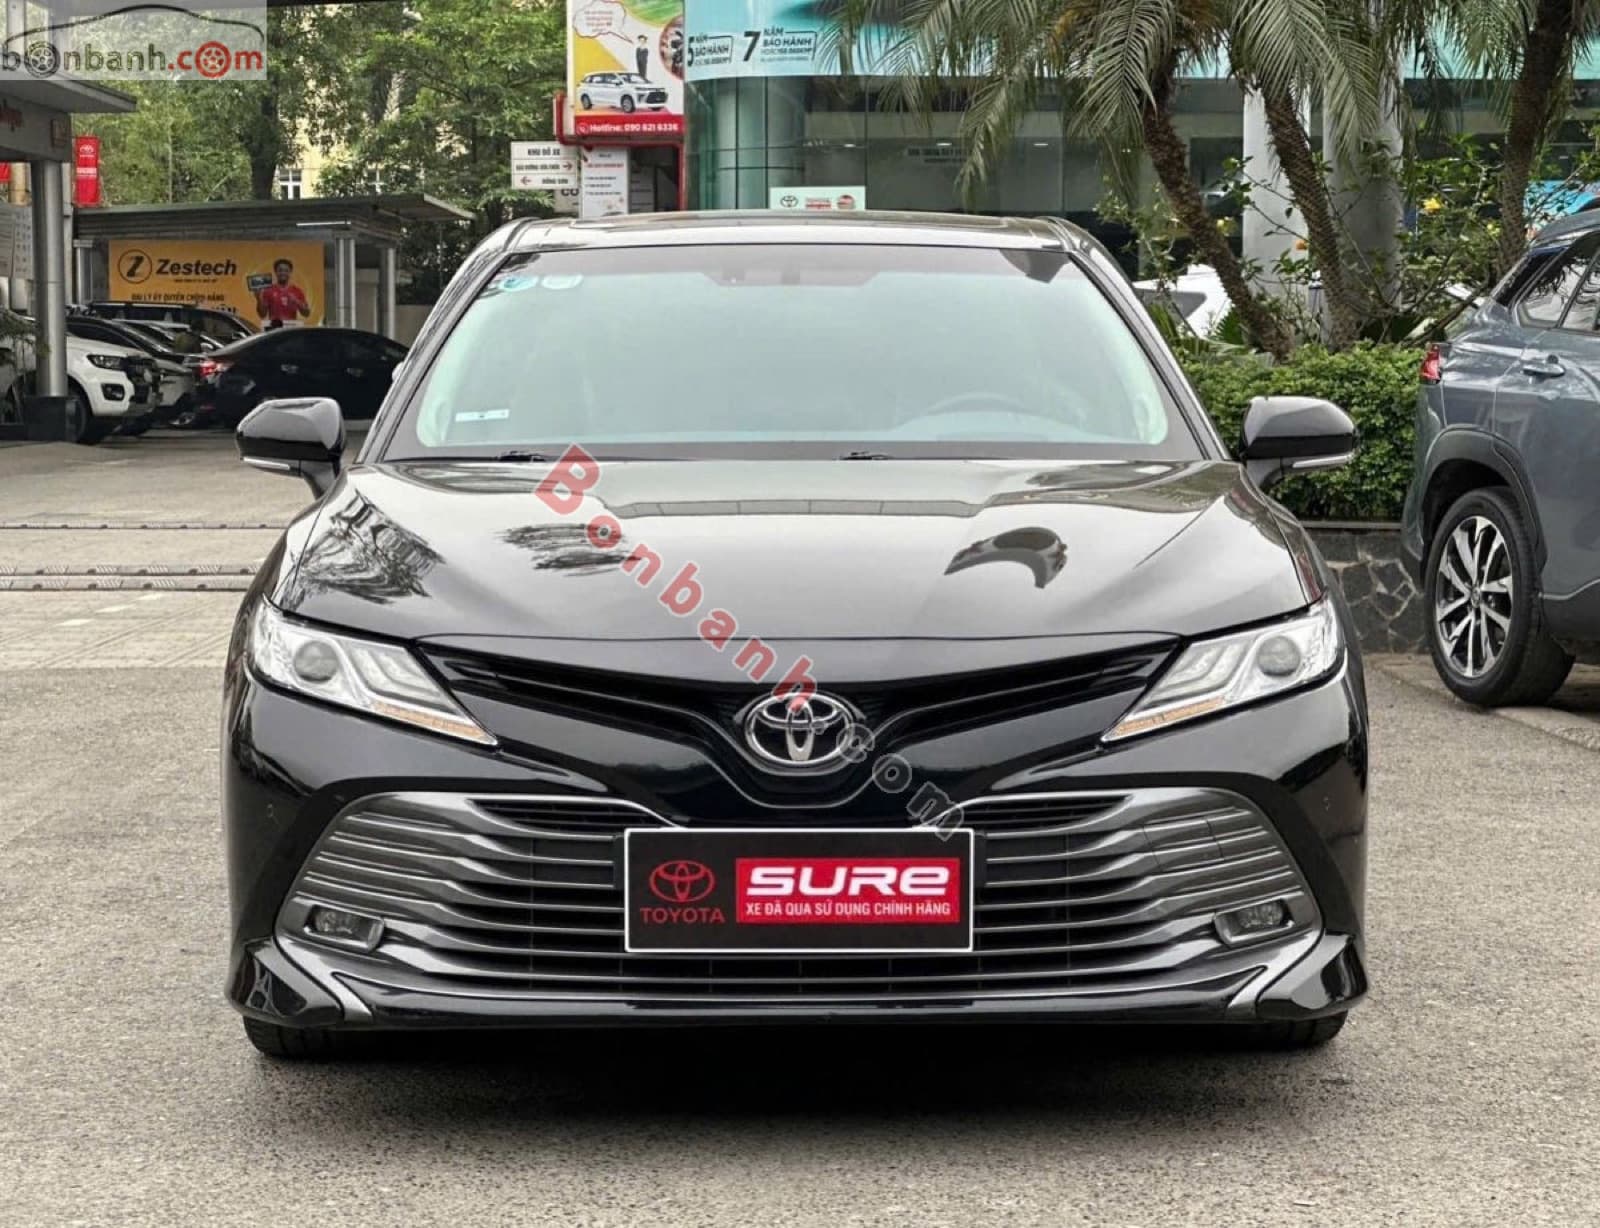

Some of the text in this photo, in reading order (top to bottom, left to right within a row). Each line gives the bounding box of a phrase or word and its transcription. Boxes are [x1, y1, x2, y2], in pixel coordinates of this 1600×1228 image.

[743, 31, 761, 62] 7
[783, 37, 812, 46] HÀNH
[156, 259, 237, 275] Zestech
[640, 907, 725, 924] TOYOTA
[746, 902, 761, 916] XE
[764, 900, 781, 916] ĐÃ
[785, 902, 812, 916] QUA
[815, 898, 833, 916] SỬ
[835, 902, 871, 917] DỤNG
[874, 900, 912, 916] CHÍNH
